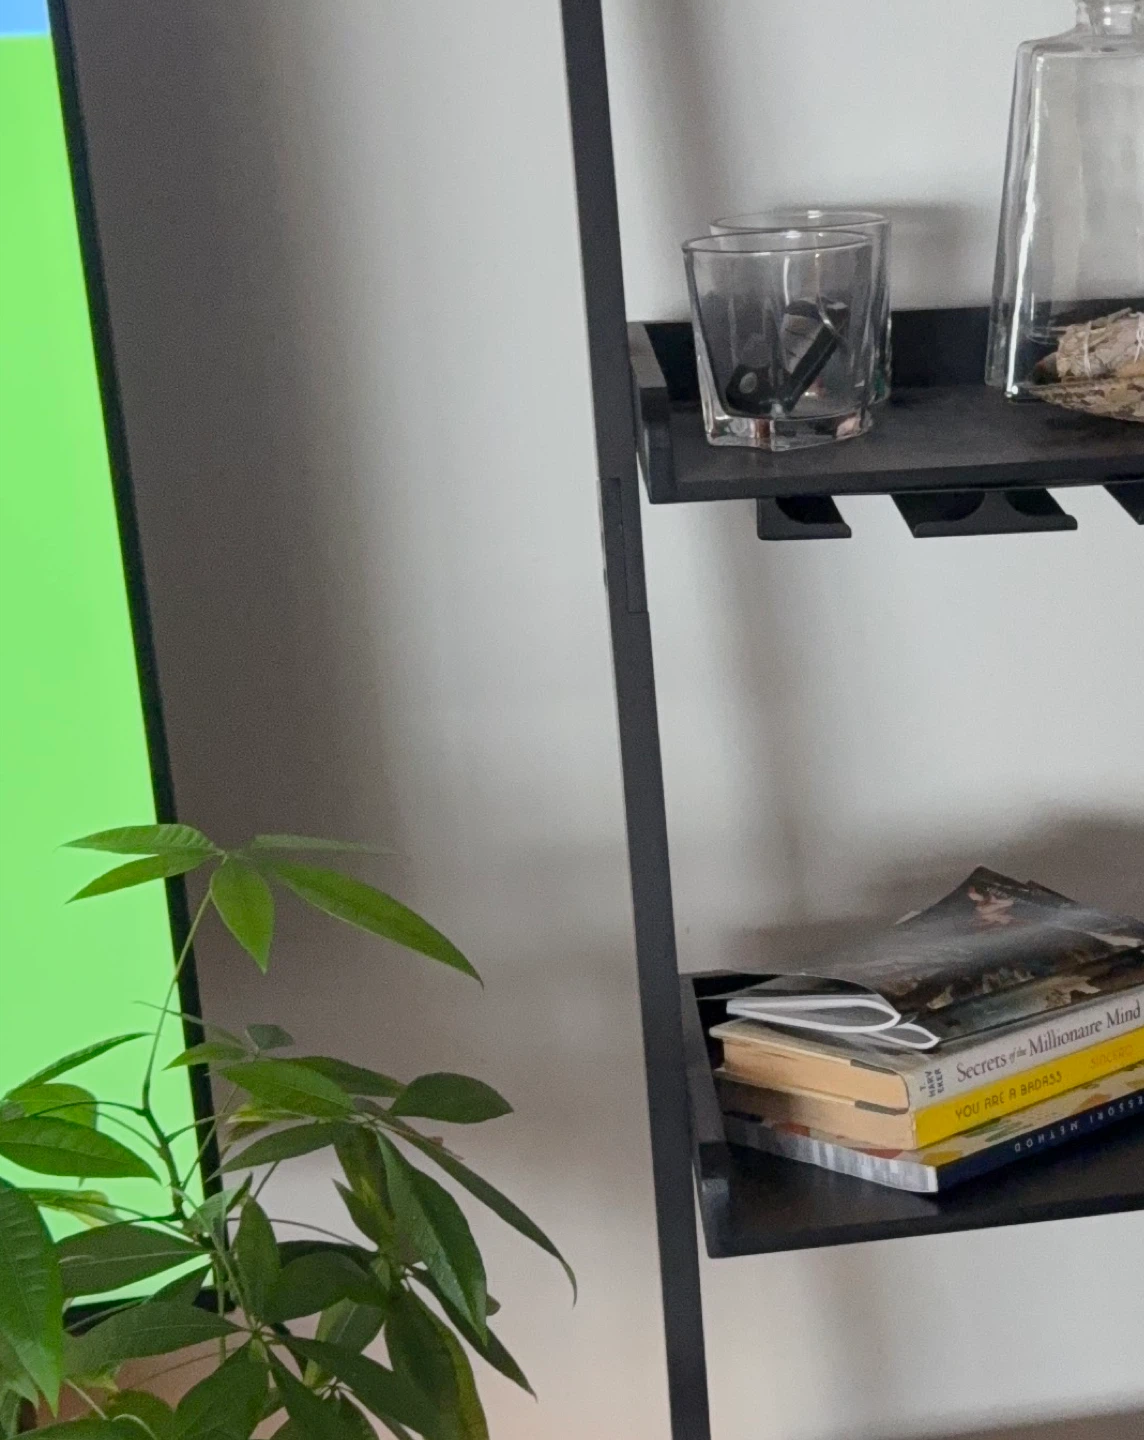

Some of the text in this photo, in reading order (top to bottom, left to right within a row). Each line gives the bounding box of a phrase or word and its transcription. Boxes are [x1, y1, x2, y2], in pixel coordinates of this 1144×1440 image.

[956, 1053, 1007, 1083] Secrets
[1028, 1020, 1103, 1058] Millionaire
[1106, 998, 1141, 1029] Mind
[955, 1101, 980, 1121] YOU
[984, 1092, 1005, 1111] ARE
[1020, 1071, 1063, 1097] BADASS
[1014, 1122, 1079, 1153] METHOD
